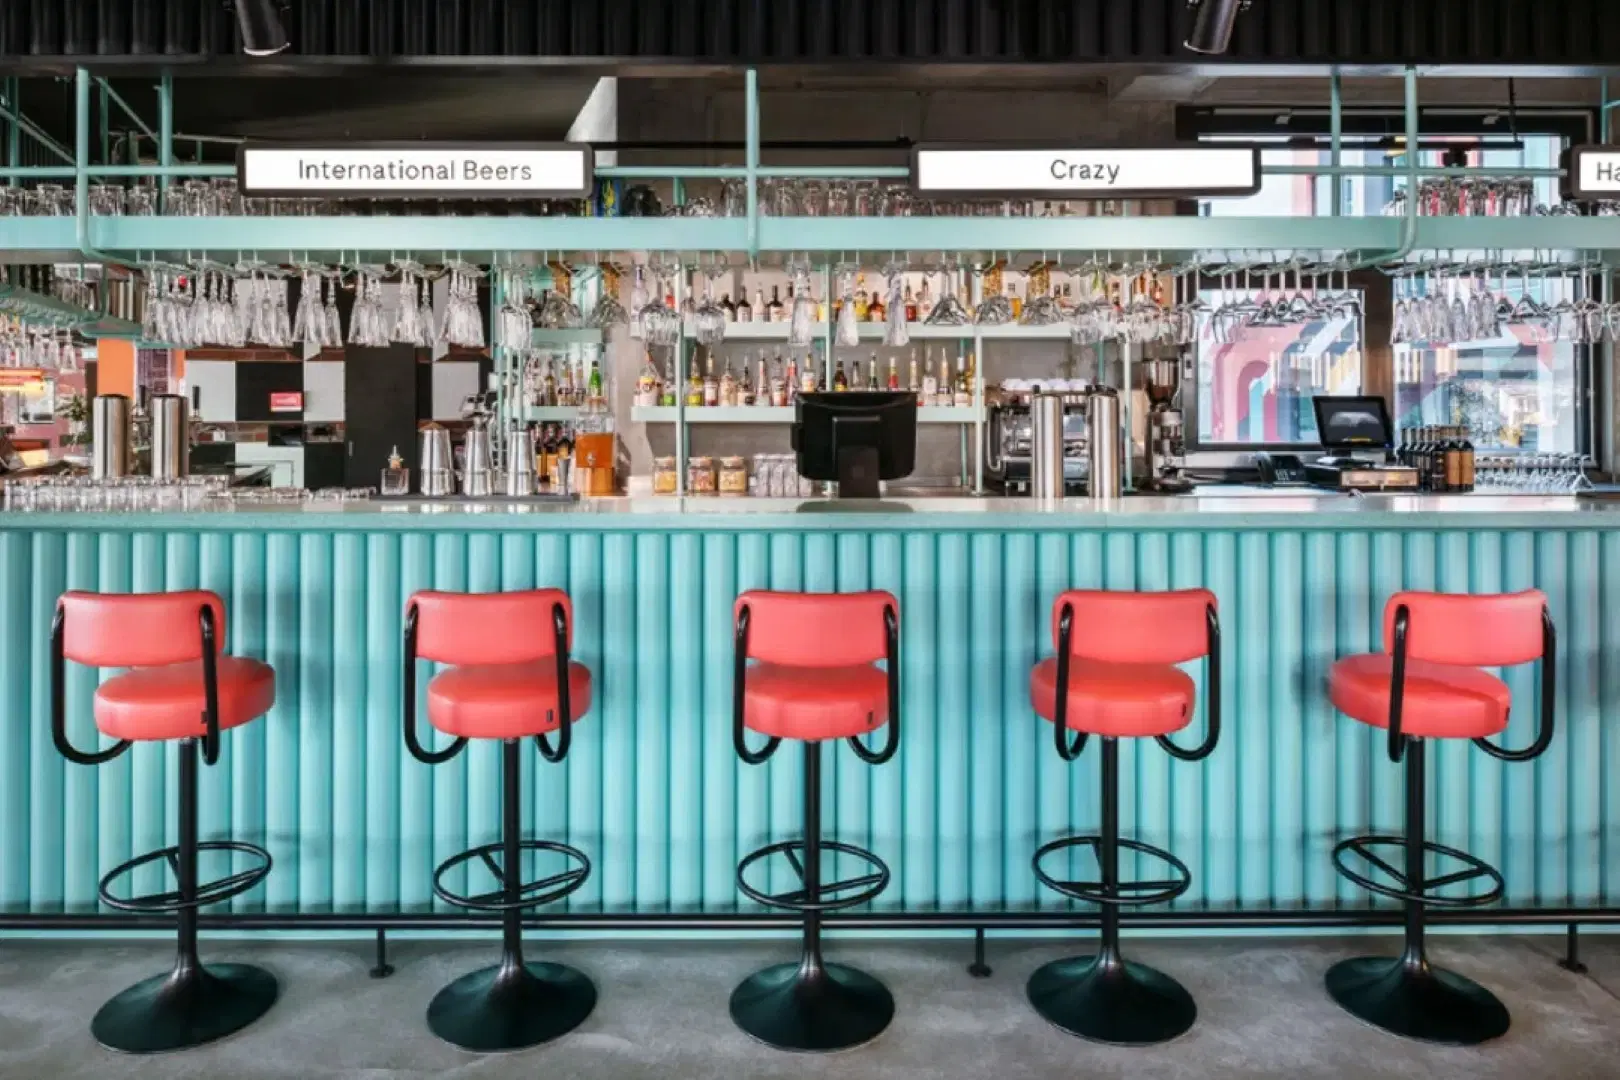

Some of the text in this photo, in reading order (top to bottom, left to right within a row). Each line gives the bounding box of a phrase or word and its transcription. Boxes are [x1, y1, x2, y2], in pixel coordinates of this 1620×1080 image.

[299, 160, 532, 180] International Beers
[1050, 159, 1120, 185] Crazy
